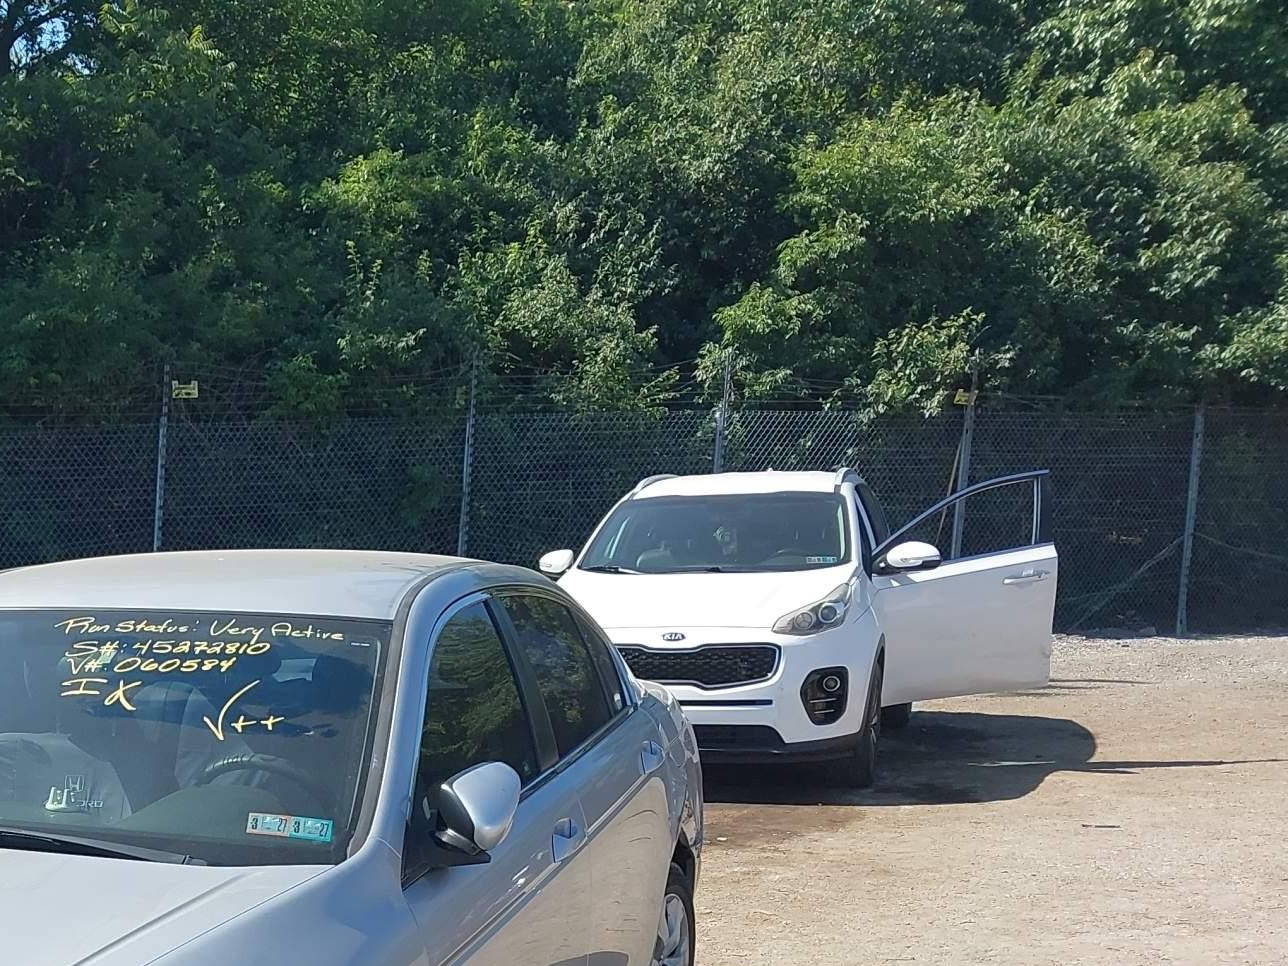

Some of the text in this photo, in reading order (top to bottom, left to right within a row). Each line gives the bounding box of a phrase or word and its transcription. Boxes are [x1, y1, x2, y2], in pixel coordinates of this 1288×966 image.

[209, 619, 266, 645] Very
[270, 622, 345, 641] Active
[663, 632, 683, 640] KIA
[132, 639, 272, 657] 45272810
[113, 657, 237, 674] 060584
